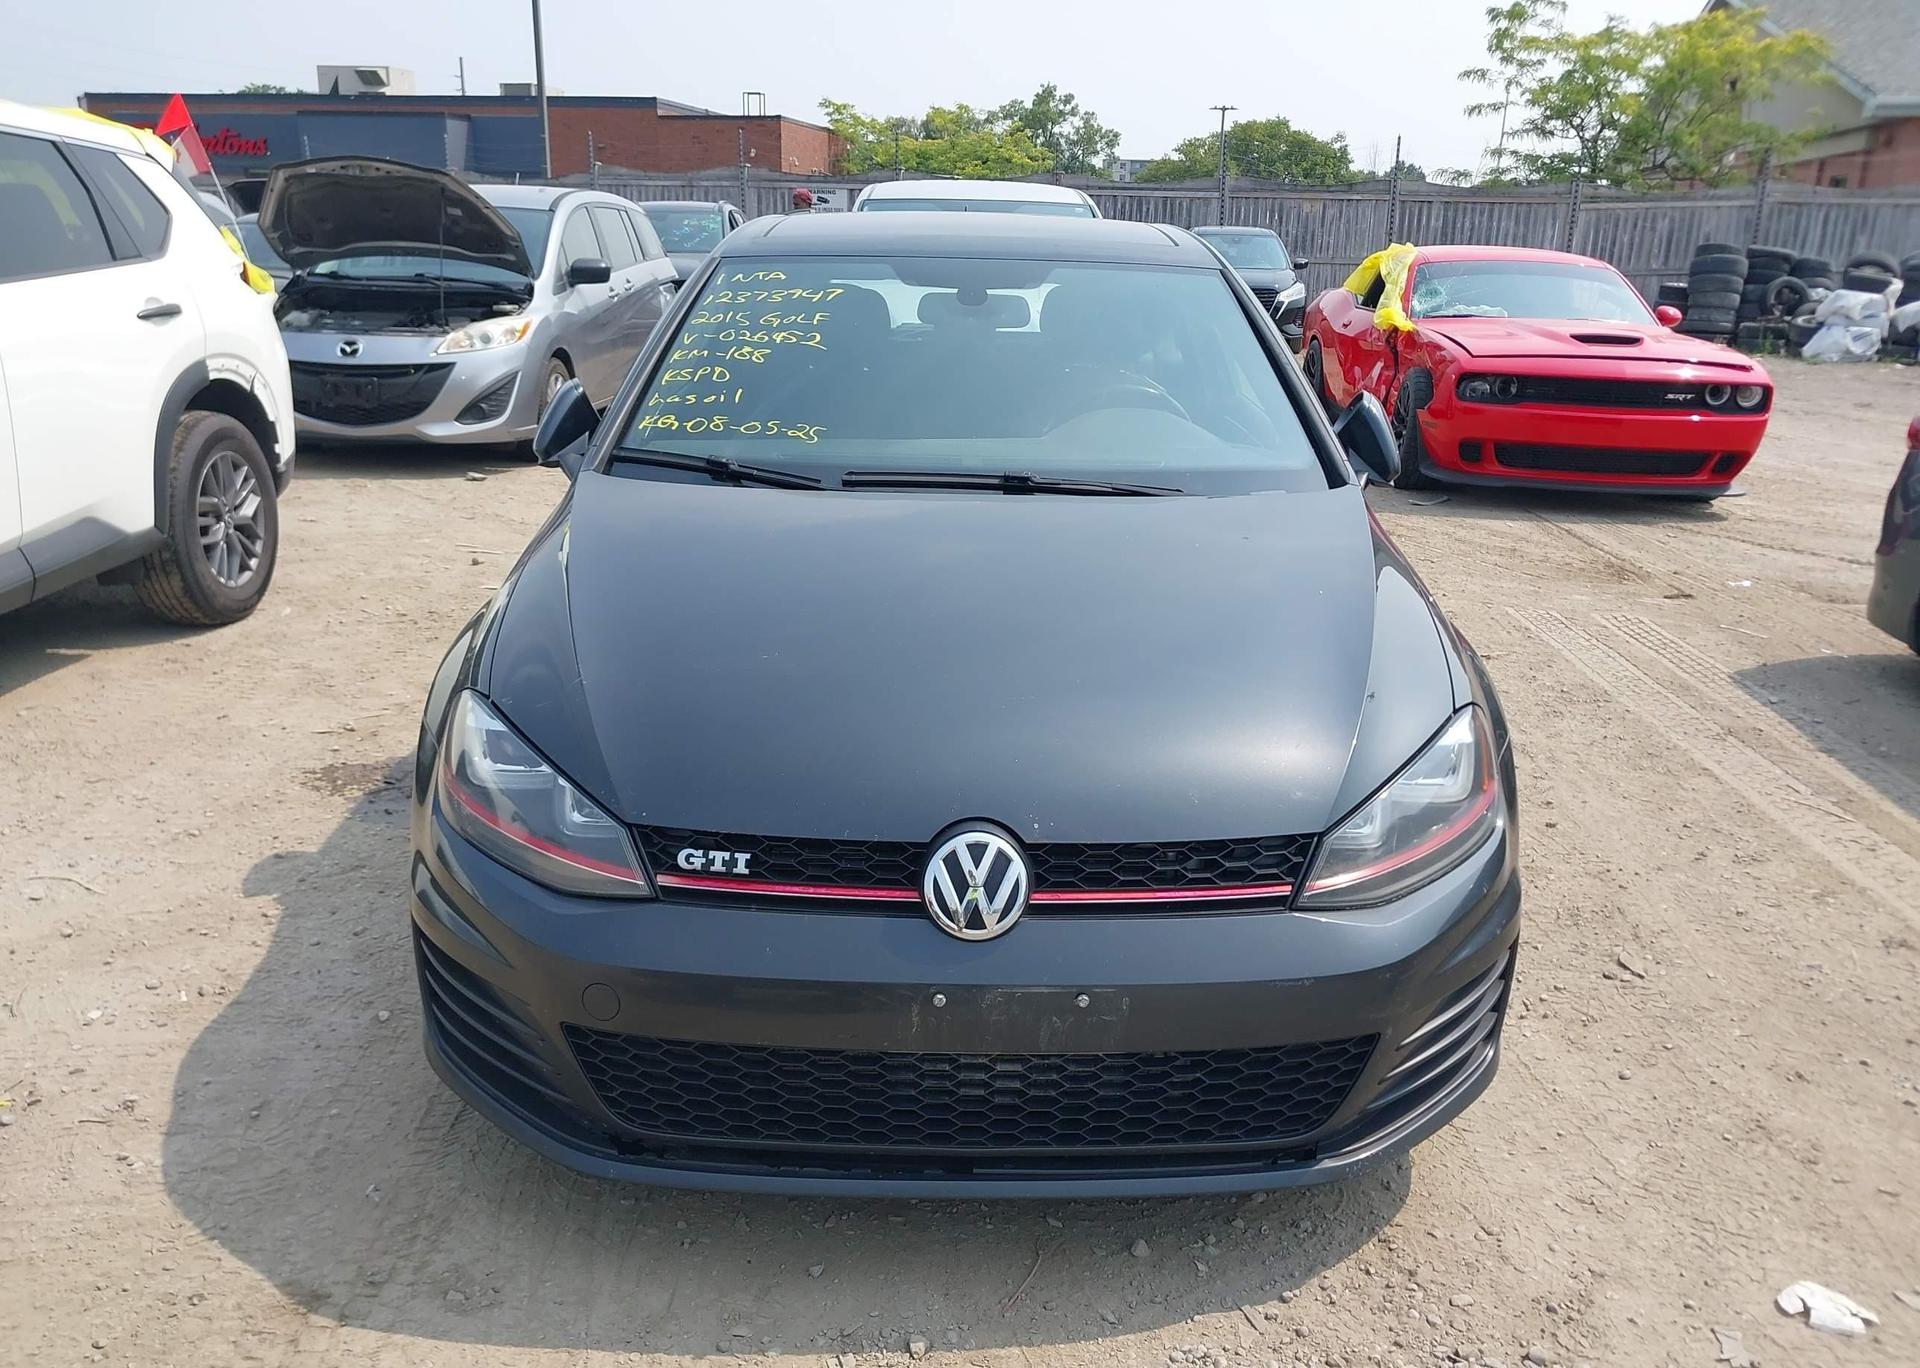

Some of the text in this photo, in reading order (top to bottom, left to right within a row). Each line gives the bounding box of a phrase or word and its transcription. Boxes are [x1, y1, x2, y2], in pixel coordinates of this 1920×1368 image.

[691, 311, 751, 326] 2015
[1664, 393, 1696, 401] SRT
[676, 848, 751, 875] GTI
